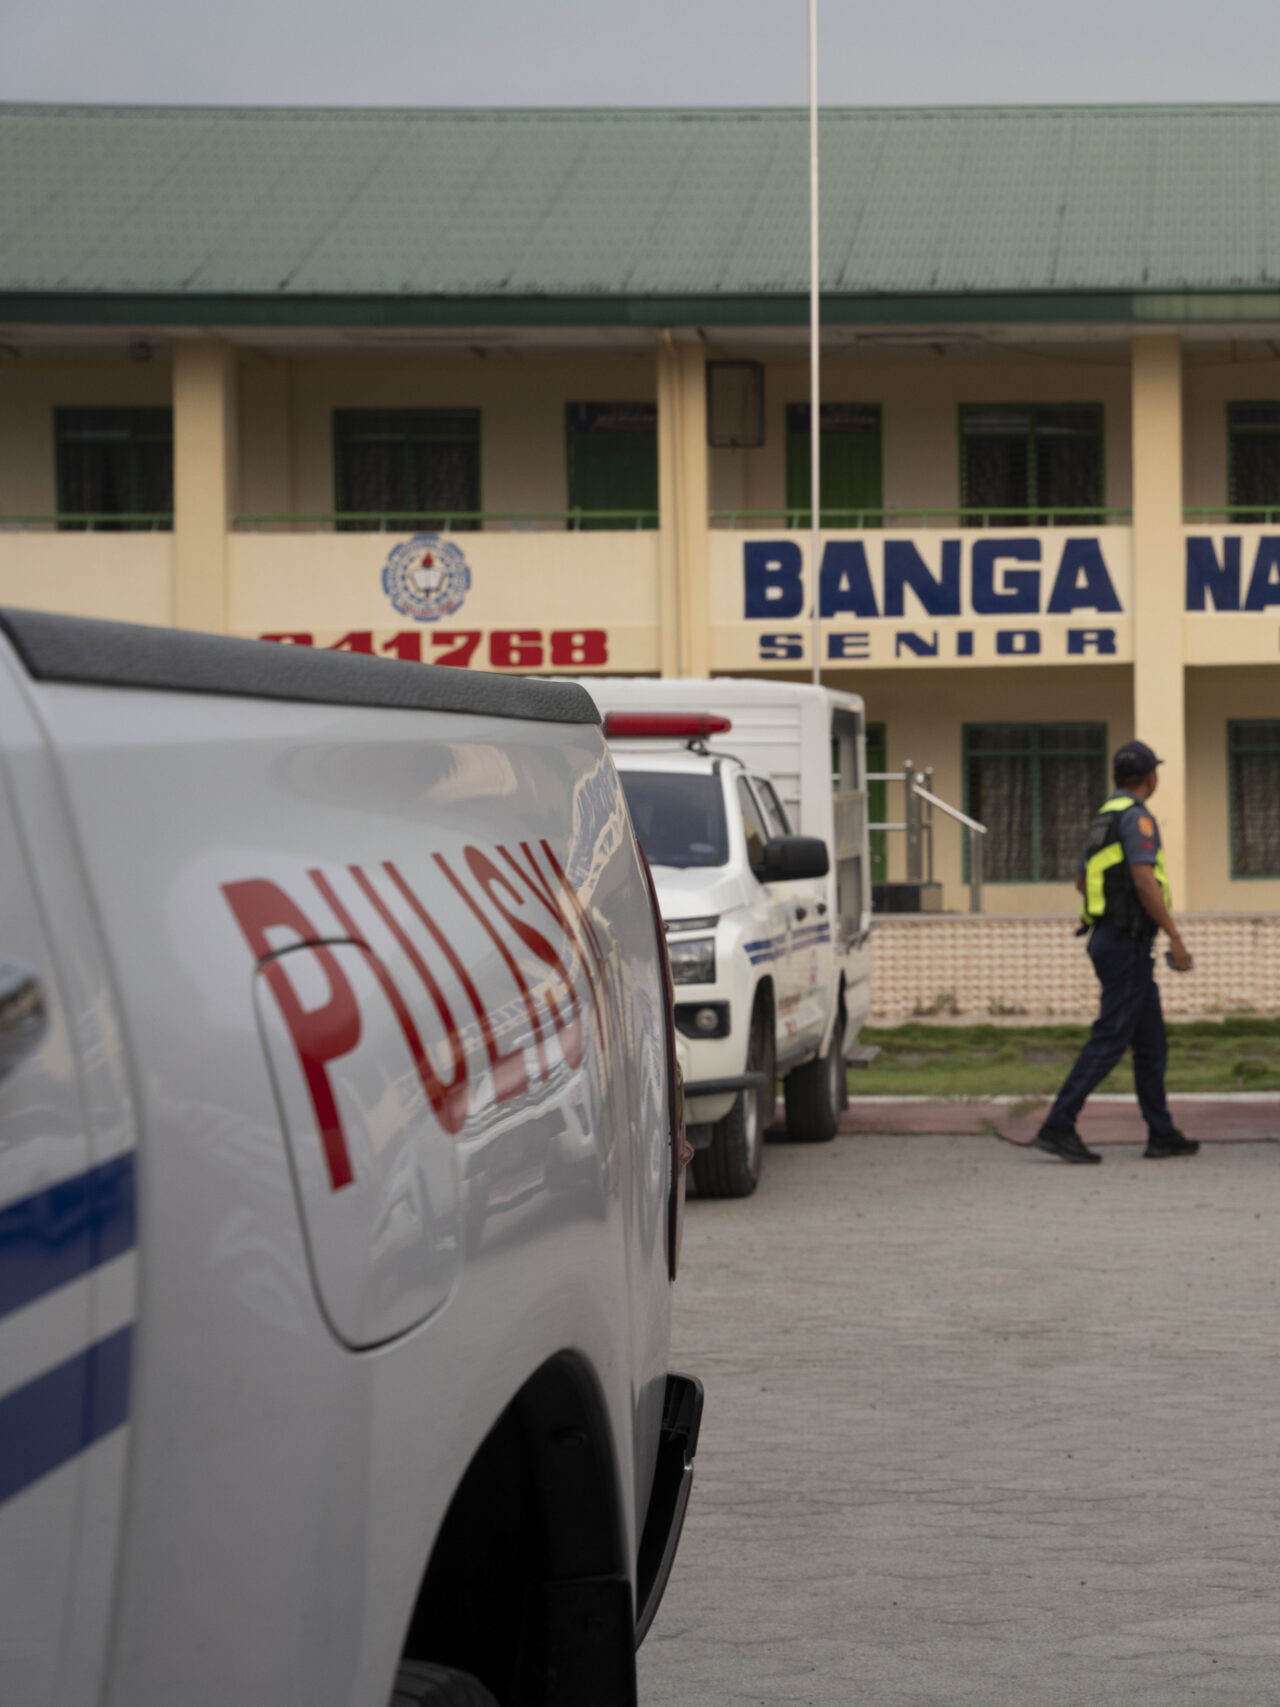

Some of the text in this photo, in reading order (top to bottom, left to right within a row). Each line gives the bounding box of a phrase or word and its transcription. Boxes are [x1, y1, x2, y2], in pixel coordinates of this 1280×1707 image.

[744, 538, 1122, 619] BANGA
[259, 629, 609, 668] 41768
[759, 627, 1117, 660] SENIOR
